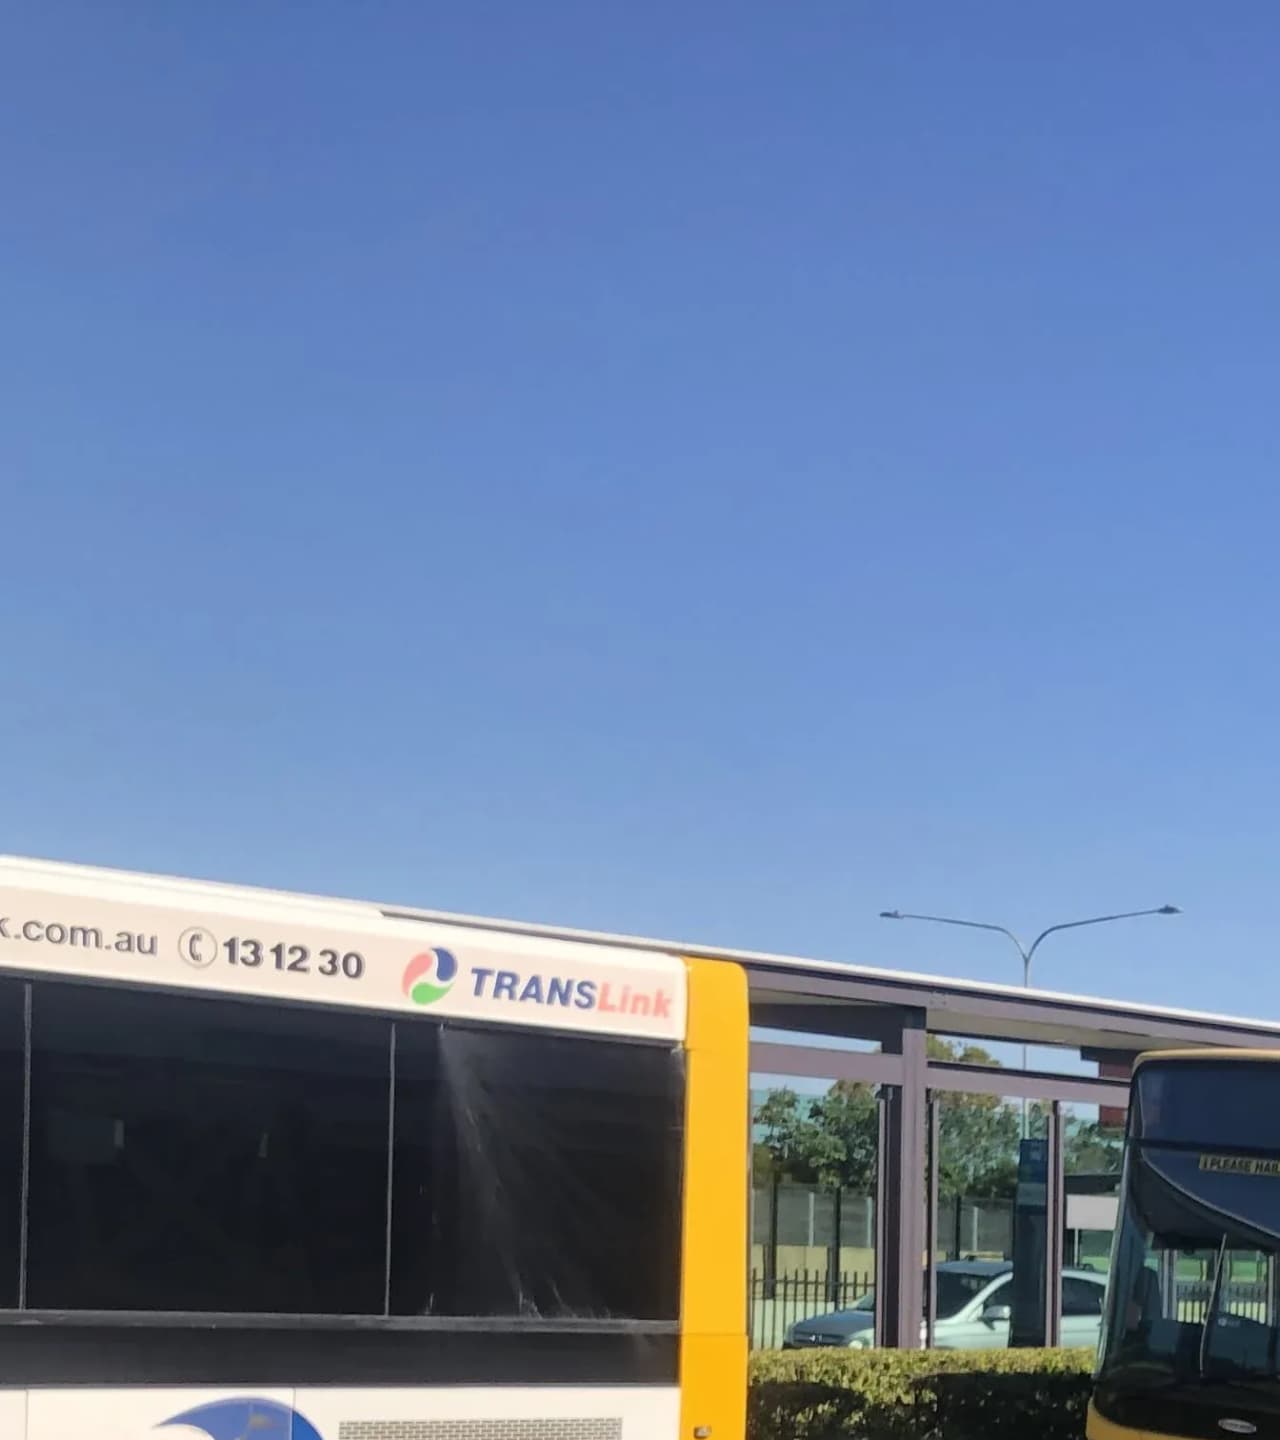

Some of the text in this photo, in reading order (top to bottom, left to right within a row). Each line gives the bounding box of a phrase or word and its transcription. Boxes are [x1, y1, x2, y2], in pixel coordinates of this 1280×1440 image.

[223, 937, 263, 967] 13
[270, 942, 311, 973] 12
[318, 949, 366, 979] 30
[471, 967, 673, 1017] TRANSLink
